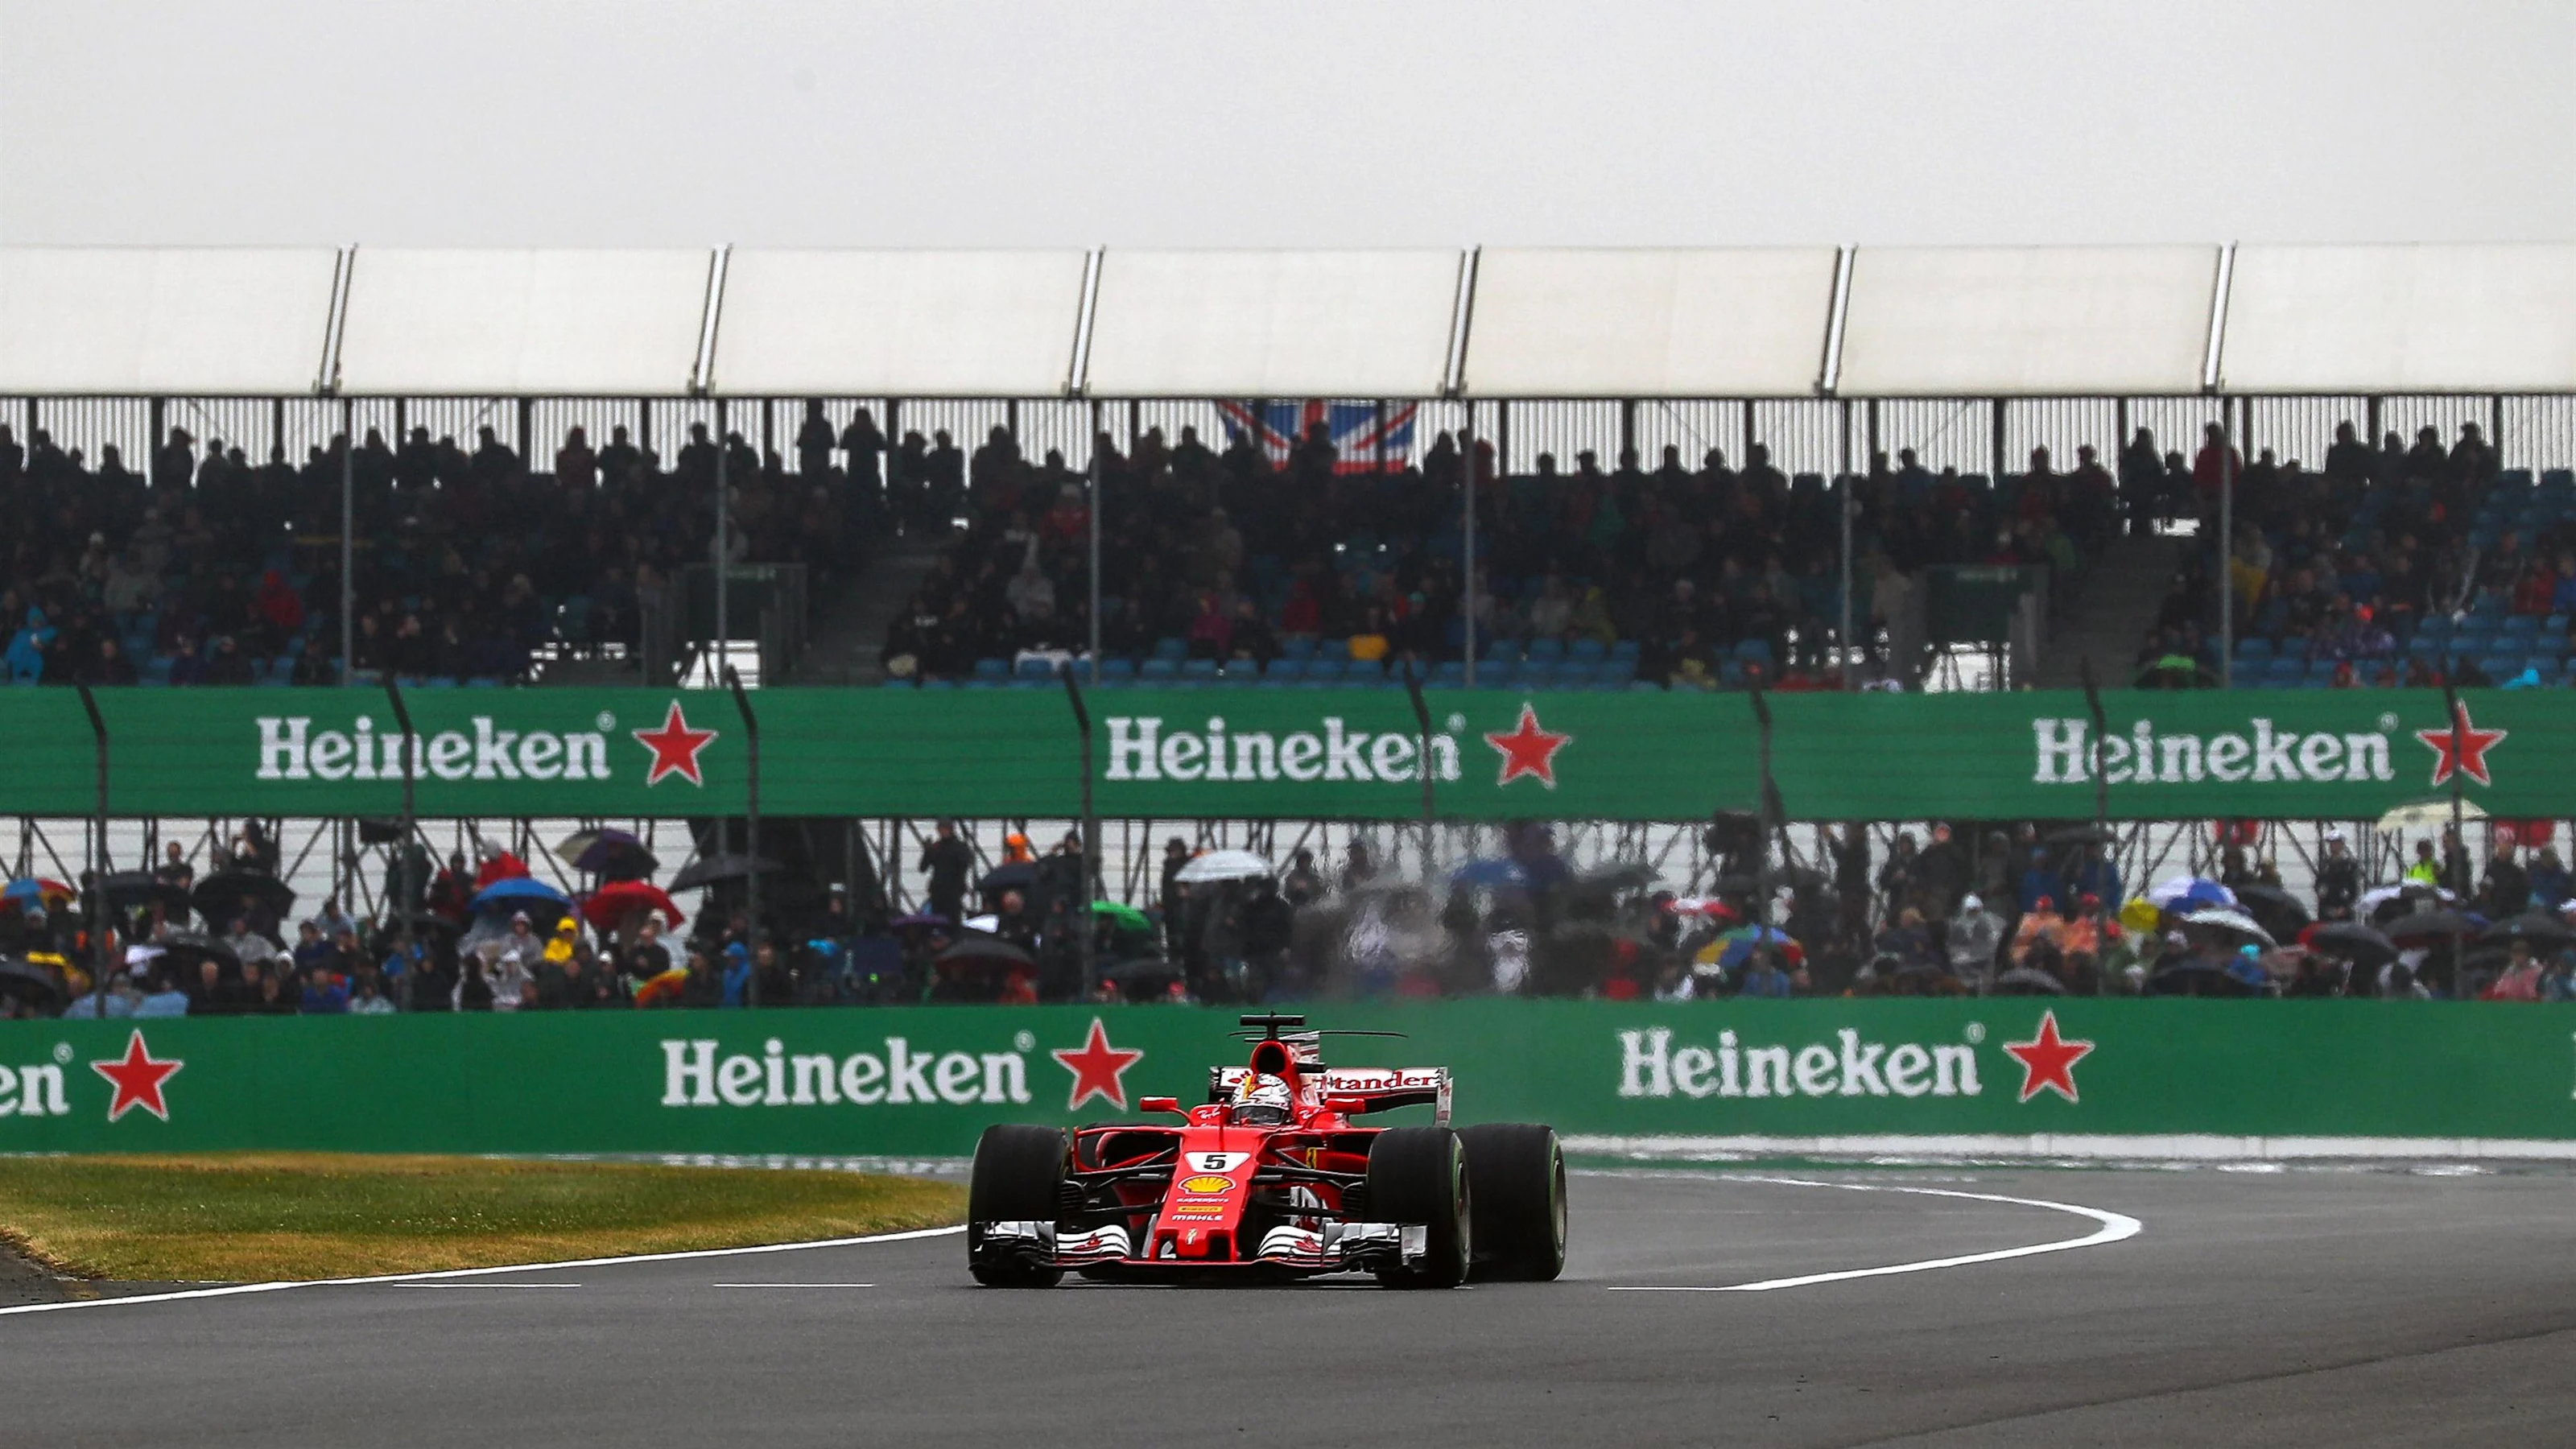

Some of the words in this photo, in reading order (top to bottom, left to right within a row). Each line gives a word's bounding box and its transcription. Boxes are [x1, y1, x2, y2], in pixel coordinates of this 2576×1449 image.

[256, 716, 611, 780] Heineken
[1105, 716, 1461, 782] Heineken
[2033, 718, 2395, 782] Heineken
[660, 1037, 1031, 1106] Heineken
[1616, 1027, 1983, 1098] Heineken
[1203, 1154, 1227, 1170] 5
